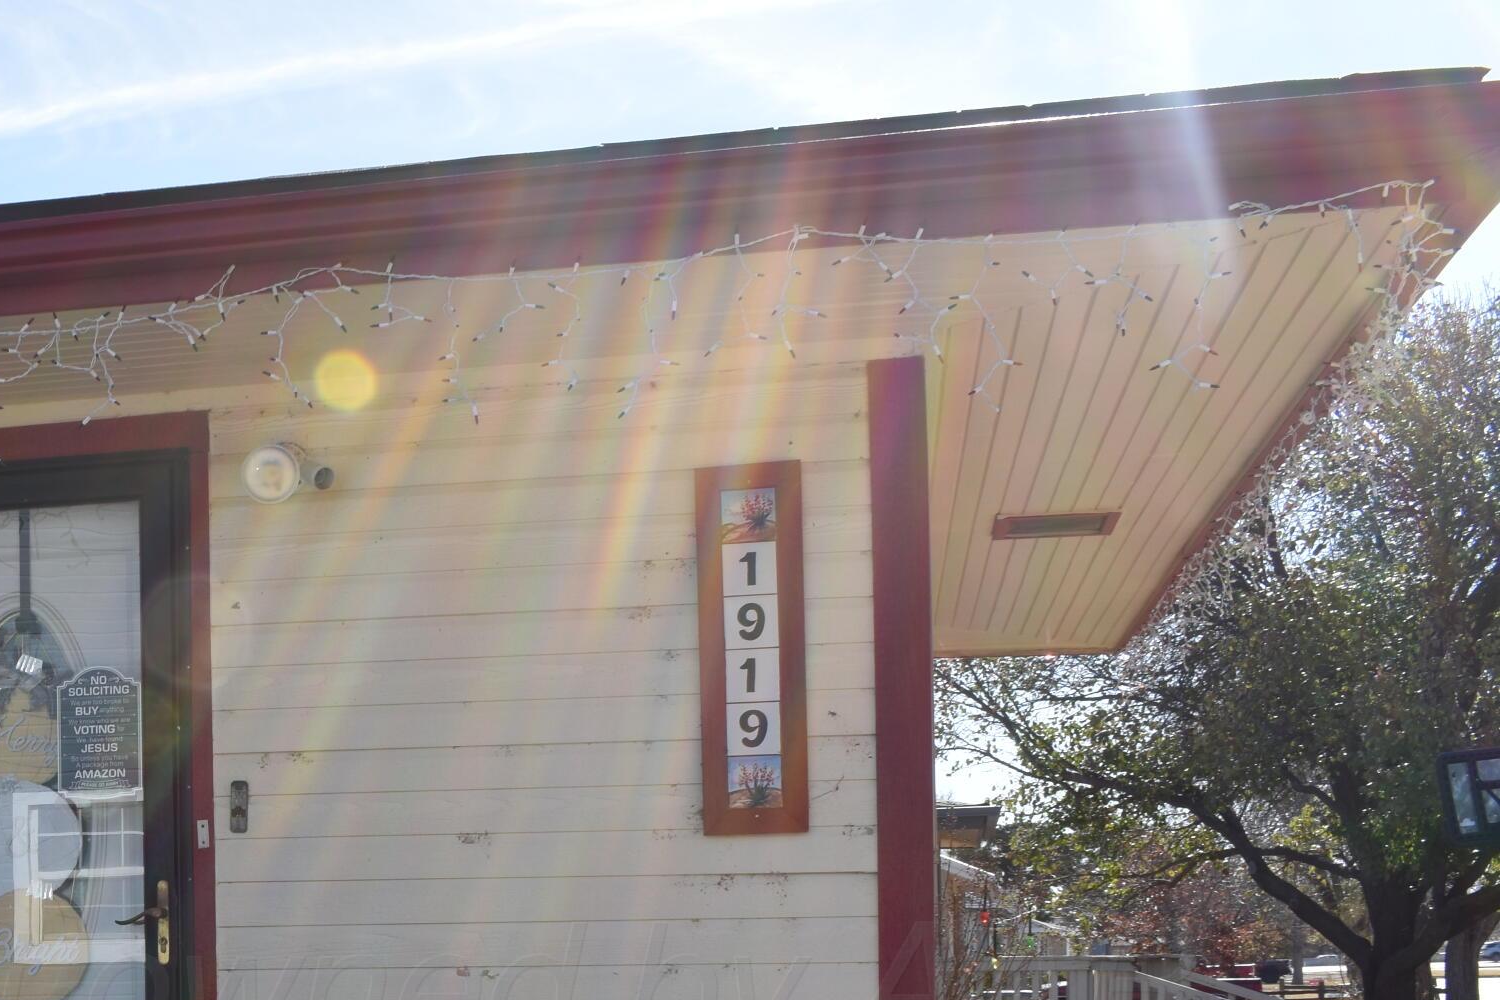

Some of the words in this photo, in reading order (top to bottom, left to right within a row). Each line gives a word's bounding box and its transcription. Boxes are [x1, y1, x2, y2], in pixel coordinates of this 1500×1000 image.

[737, 551, 768, 748] 1919
[90, 675, 107, 685] NO
[68, 685, 130, 697] SOLICITING
[75, 706, 99, 716] BUY
[73, 724, 116, 735] VOTING
[81, 742, 118, 753] JESUS
[74, 768, 126, 779] AMAZON
